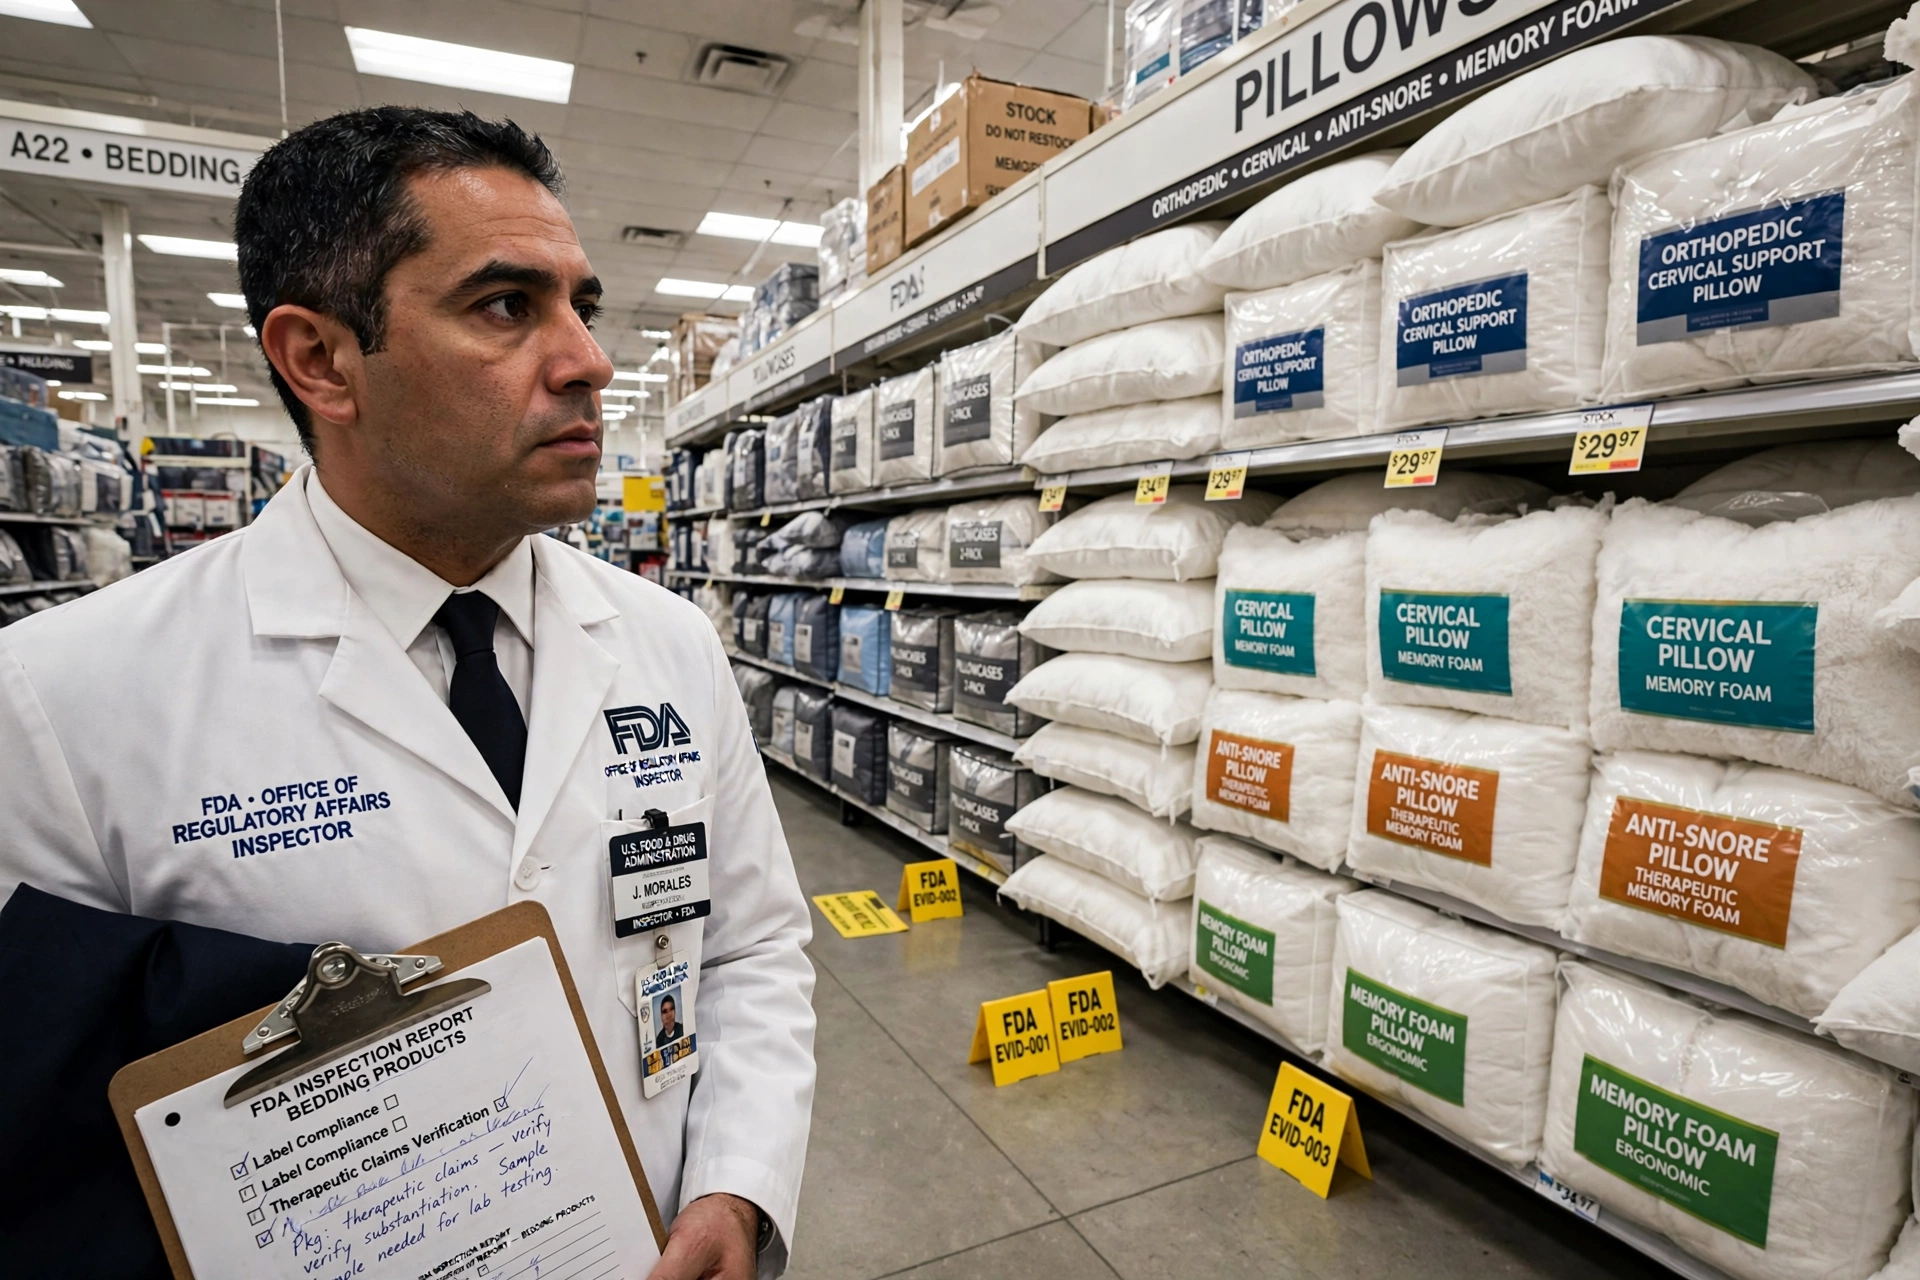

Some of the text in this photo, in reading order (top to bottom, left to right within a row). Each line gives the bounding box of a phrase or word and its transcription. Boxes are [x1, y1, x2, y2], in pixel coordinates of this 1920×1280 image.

[1235, 0, 1499, 134] PILLOW
[1006, 101, 1056, 126] STOCK
[1152, 168, 1229, 219] ORTHOPEDIC
[1241, 131, 1310, 178] CERVICAL
[1326, 74, 1432, 141] ANTI-SNORE
[1456, 16, 1555, 84] MEMORY
[986, 124, 1001, 138] DO
[1004, 127, 1026, 144] NOT
[11, 130, 241, 185] A22 BEDDING
[1662, 216, 1802, 265] ORTHOPEDIC
[1648, 239, 1826, 290] CERVICAL SUPPORT
[1693, 274, 1762, 303] PILLOW
[1411, 289, 1502, 323] ORTHOPEDIC
[1403, 308, 1517, 344] CERVICAL SUPPORT
[1242, 340, 1306, 366] ORTHOPEDIC
[1432, 334, 1477, 355] PILLOW
[1237, 357, 1317, 382] CERVICAL SUPPORT
[1257, 377, 1289, 394] PILLOW
[1234, 599, 1294, 620] CERVICAL
[1396, 603, 1480, 628] CERVICAL
[1240, 618, 1286, 639] PILLOW
[1406, 625, 1470, 650] PILLOW
[1646, 615, 1772, 645] CERVICAL
[1234, 639, 1295, 657] MEMORY FOAM
[1398, 650, 1483, 672] MEMORY FOAM
[1659, 643, 1755, 673] PILLOW
[1646, 675, 1772, 702] MEMORY FOAM
[602, 702, 691, 755] FDA
[1215, 739, 1282, 769] ANTI-SNORE
[633, 768, 684, 788] INSPECTOR
[1225, 759, 1267, 784] PILLOW
[1381, 762, 1480, 801] ANTI-SNORE
[201, 775, 358, 816] FDA OFFICE OF
[1397, 786, 1458, 818] PILLOW
[172, 791, 391, 844] REGULATORY AFFAIRS
[1390, 806, 1460, 836] THERAPEUTIC
[232, 820, 354, 859] INSPECTOR
[621, 832, 696, 856] U.S. FOOD & DRUG
[1385, 819, 1463, 852] MEMORY FOAM
[1625, 813, 1771, 863] ANTI-SNORE
[920, 869, 947, 889] FDA
[1648, 842, 1740, 883] PILLOW
[633, 874, 692, 900] J. MORALES
[913, 889, 958, 908] EVID-002
[1635, 866, 1738, 906] THERAPEUTIC
[681, 905, 696, 918] FDA
[1627, 882, 1740, 926] MEMORY FOAM
[1200, 911, 1268, 957] MEMORY FOAM
[1212, 934, 1248, 965] PILLOW
[1068, 987, 1102, 1016] FDA
[1350, 983, 1455, 1045] MEMORY FOAM
[1002, 1007, 1038, 1037] FDA
[1060, 1012, 1116, 1041] EVID-002
[1371, 1013, 1425, 1052] PILLOW
[250, 1006, 474, 1118] FDA INSPECTION REPORT
[995, 1033, 1050, 1064] EVID-001
[1366, 1032, 1428, 1072] ERGONOMIC
[286, 1030, 467, 1122] BEDDING PRODUCTS
[1287, 1087, 1325, 1134] FDA
[1590, 1073, 1756, 1167] MEMORY FOAM
[252, 1104, 380, 1170] Label Compliance
[1269, 1112, 1332, 1167] EVID-003
[1623, 1115, 1707, 1171] PILLOW
[261, 1163, 303, 1193] Label
[305, 1127, 389, 1172] Compliance
[269, 1166, 360, 1215] Therapeutic
[361, 1144, 411, 1173] Claims
[411, 1106, 491, 1150] Verification
[342, 1180, 426, 1230] therapeutic
[435, 1153, 479, 1183] claims
[512, 1113, 551, 1143] verify
[1615, 1138, 1710, 1197] ERGONOMIC
[303, 1239, 352, 1274] verify
[364, 1184, 478, 1245] substantiation.
[499, 1140, 549, 1176] Sample
[377, 1223, 427, 1263] needed
[437, 1211, 460, 1233] for
[470, 1193, 492, 1215] lab
[500, 1165, 559, 1198] testing.
[556, 1194, 596, 1221] PRODUCTS
